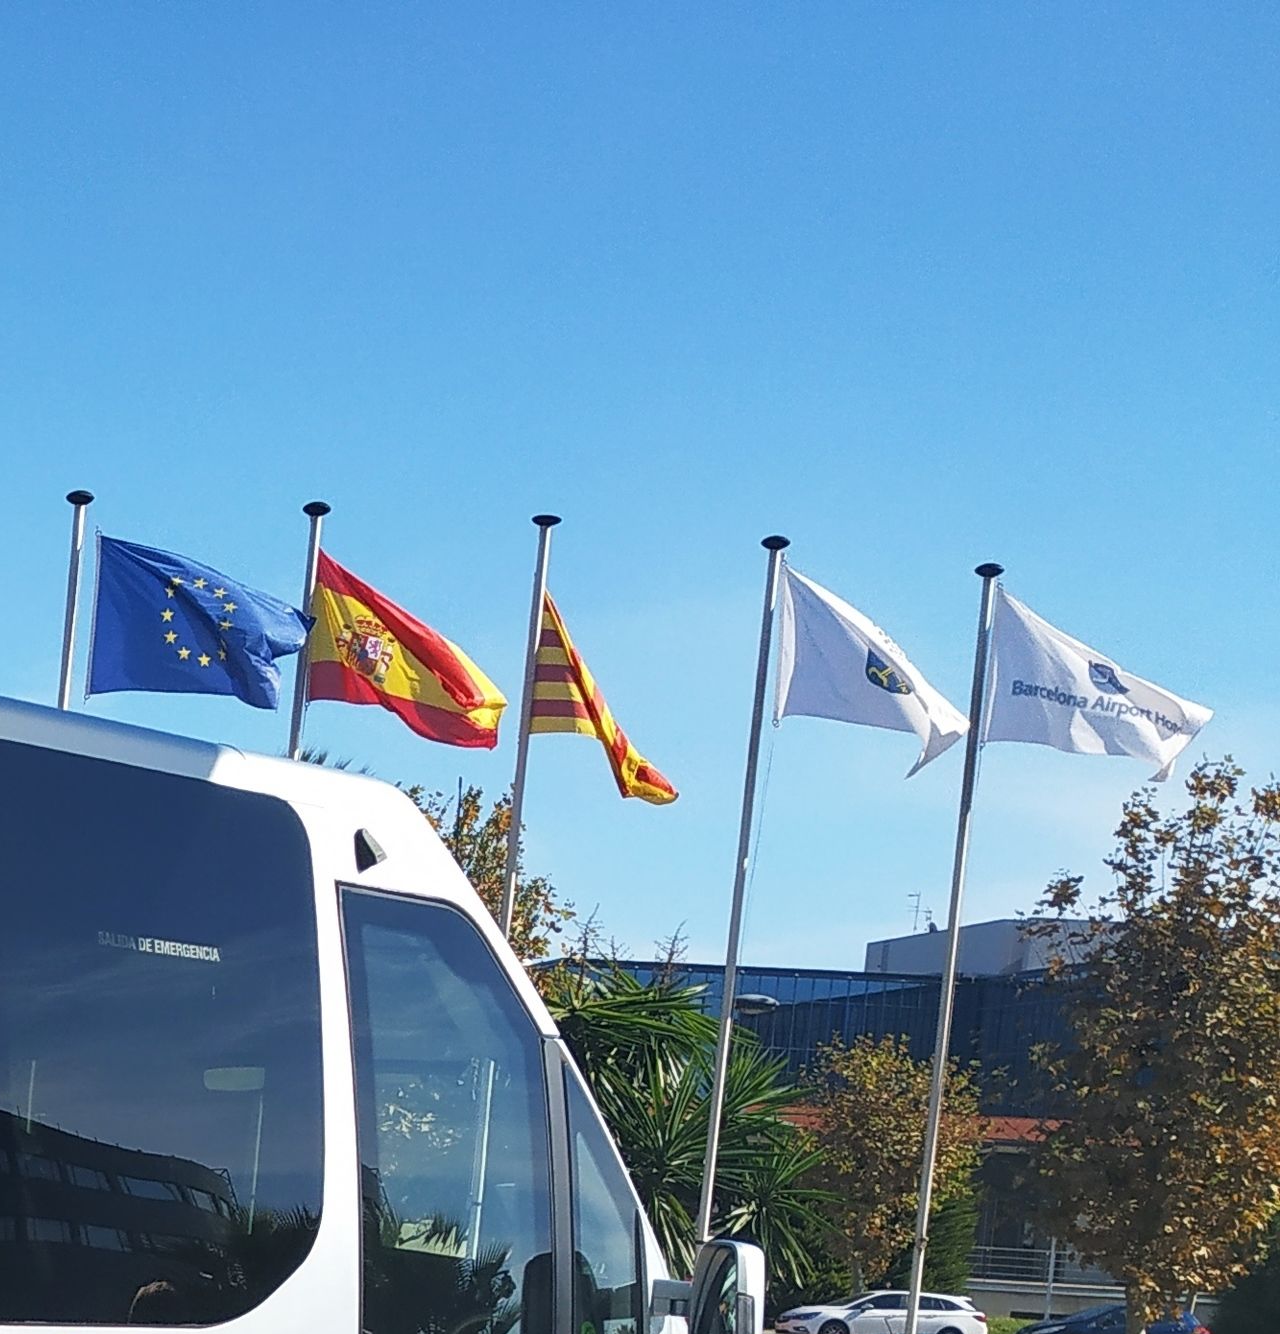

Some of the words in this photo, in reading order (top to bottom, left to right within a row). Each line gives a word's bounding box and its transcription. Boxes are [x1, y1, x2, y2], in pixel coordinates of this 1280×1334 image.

[1012, 680, 1087, 708] Barcelona
[1091, 695, 1152, 724] Airport
[98, 930, 136, 950] SALIDA
[138, 937, 153, 952] DE
[154, 939, 220, 962] EMERGENCIA
